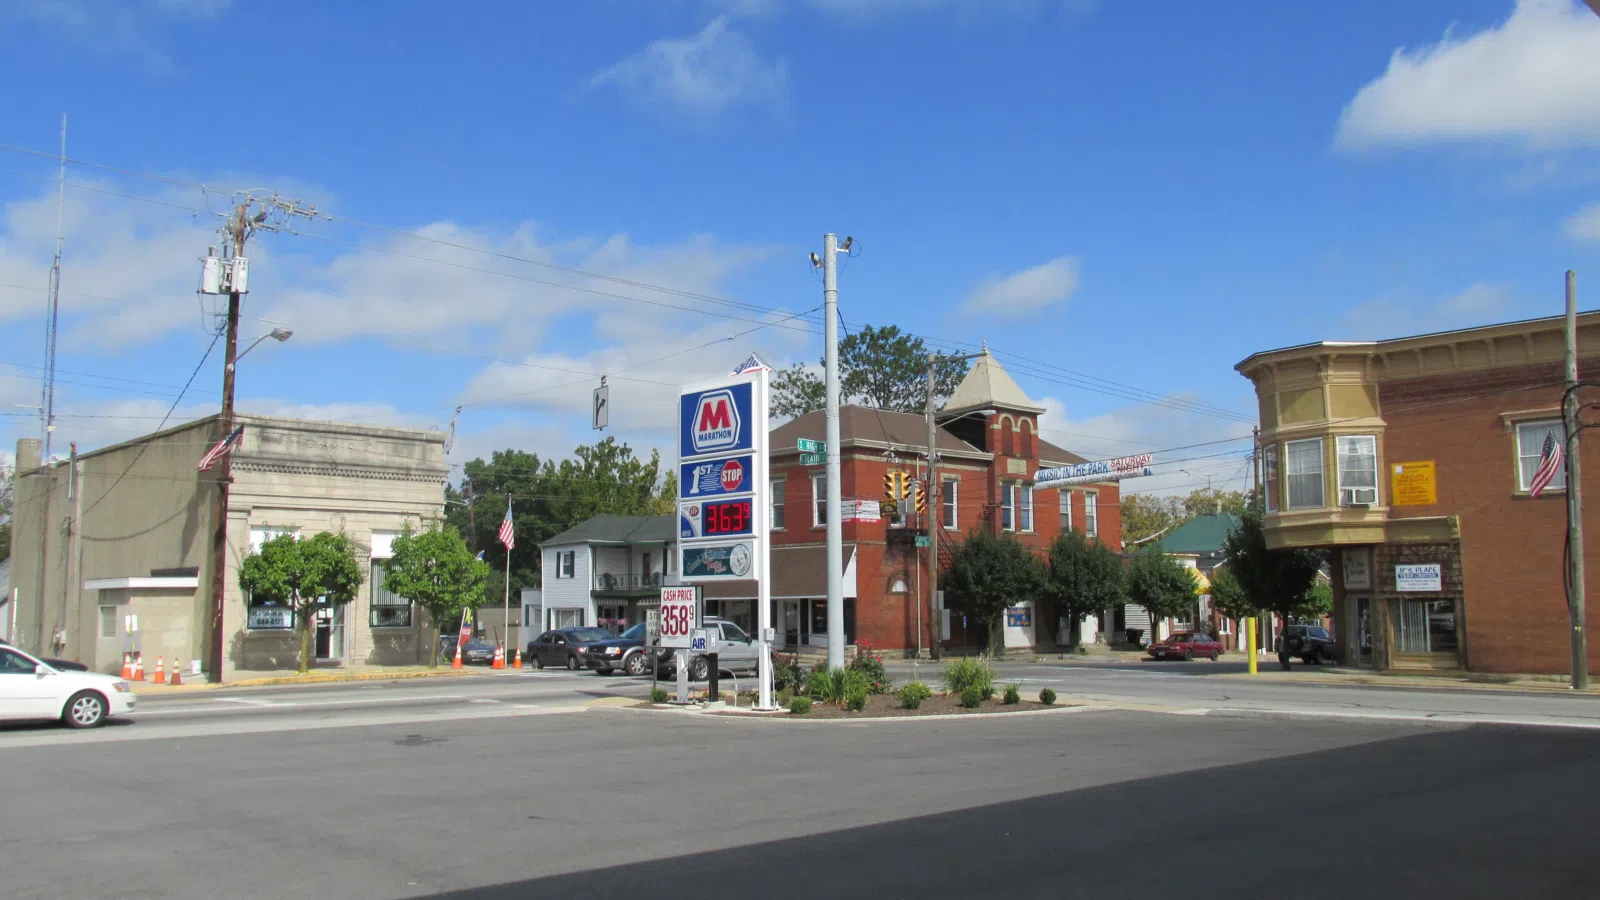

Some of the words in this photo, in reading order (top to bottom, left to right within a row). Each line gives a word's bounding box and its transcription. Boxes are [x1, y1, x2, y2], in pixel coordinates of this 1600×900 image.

[699, 400, 731, 432] M
[698, 430, 731, 441] MARATHON
[1038, 468, 1060, 482] MUSIC
[1062, 467, 1070, 478] IN
[1072, 464, 1087, 477] THE
[1089, 461, 1109, 475] PARK
[1111, 454, 1152, 467] SATURDAY
[1117, 462, 1145, 473] NIGHT
[722, 469, 742, 482] STOP
[663, 590, 677, 601] CASH
[677, 589, 693, 601] PRICE
[649, 612, 661, 620] STO
[692, 638, 706, 649] AIR
